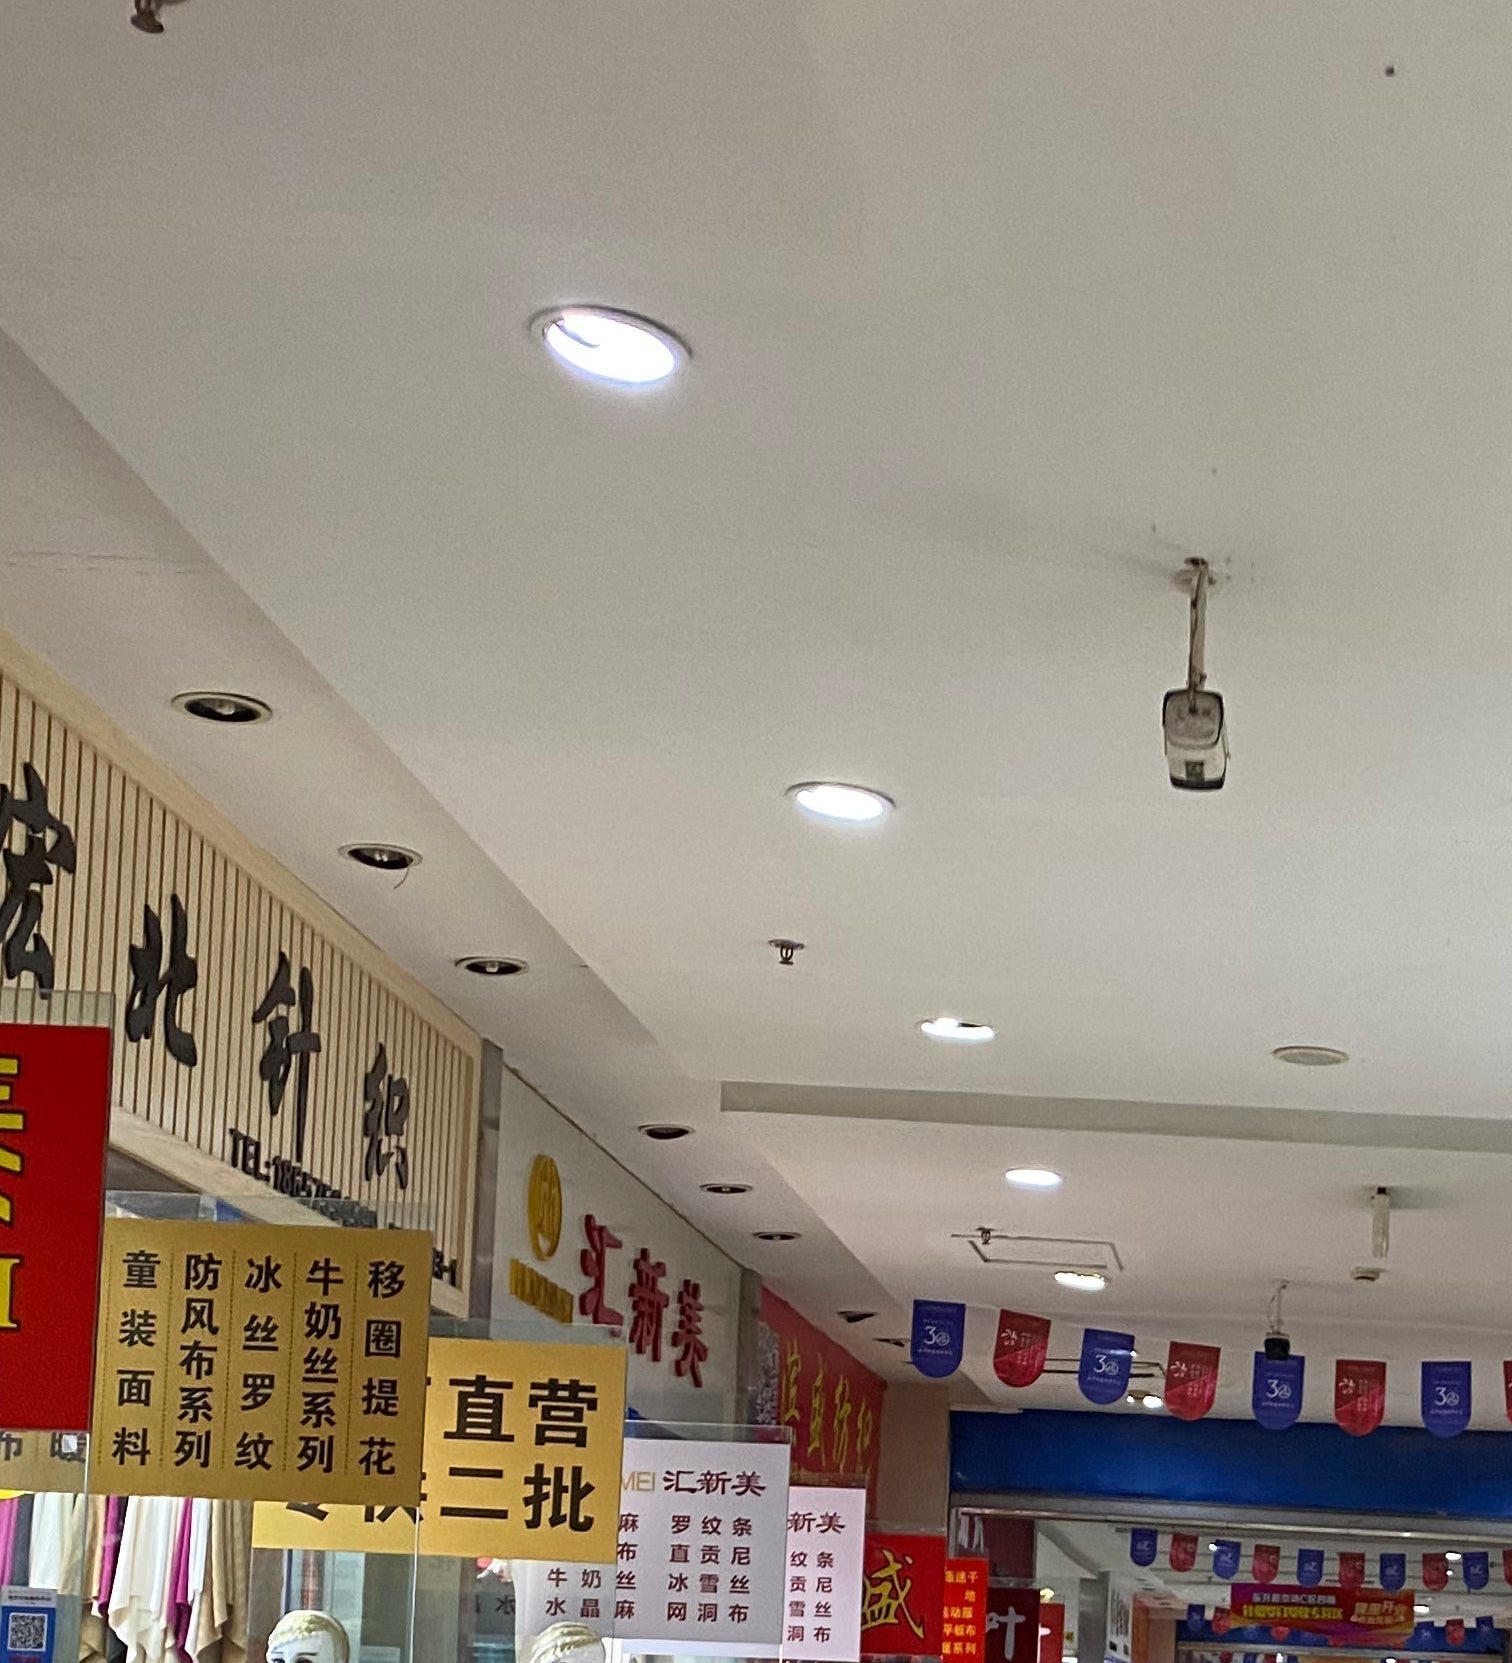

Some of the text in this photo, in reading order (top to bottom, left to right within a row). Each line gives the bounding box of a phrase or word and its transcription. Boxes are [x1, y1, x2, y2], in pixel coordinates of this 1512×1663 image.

[578, 1213, 708, 1389] 汇新美
[112, 1250, 161, 1466] 童装面料
[174, 1254, 222, 1468] 防风布系列
[235, 1256, 282, 1470] 冰丝罗纹
[297, 1258, 344, 1473] 牛奶丝系列
[358, 1259, 405, 1476] 移圈提花
[426, 1374, 598, 1448] 直营
[663, 1470, 767, 1496] 汇新美
[671, 1515, 752, 1536] 罗纹条
[669, 1543, 751, 1565] 直贡尼
[790, 1551, 834, 1569] 纹条
[547, 1568, 751, 1594] 牛奶丝 冰雪丝
[789, 1576, 833, 1593] 贡尼
[545, 1597, 749, 1623] 水晶麻 网洞布
[788, 1626, 832, 1643] 洞布
